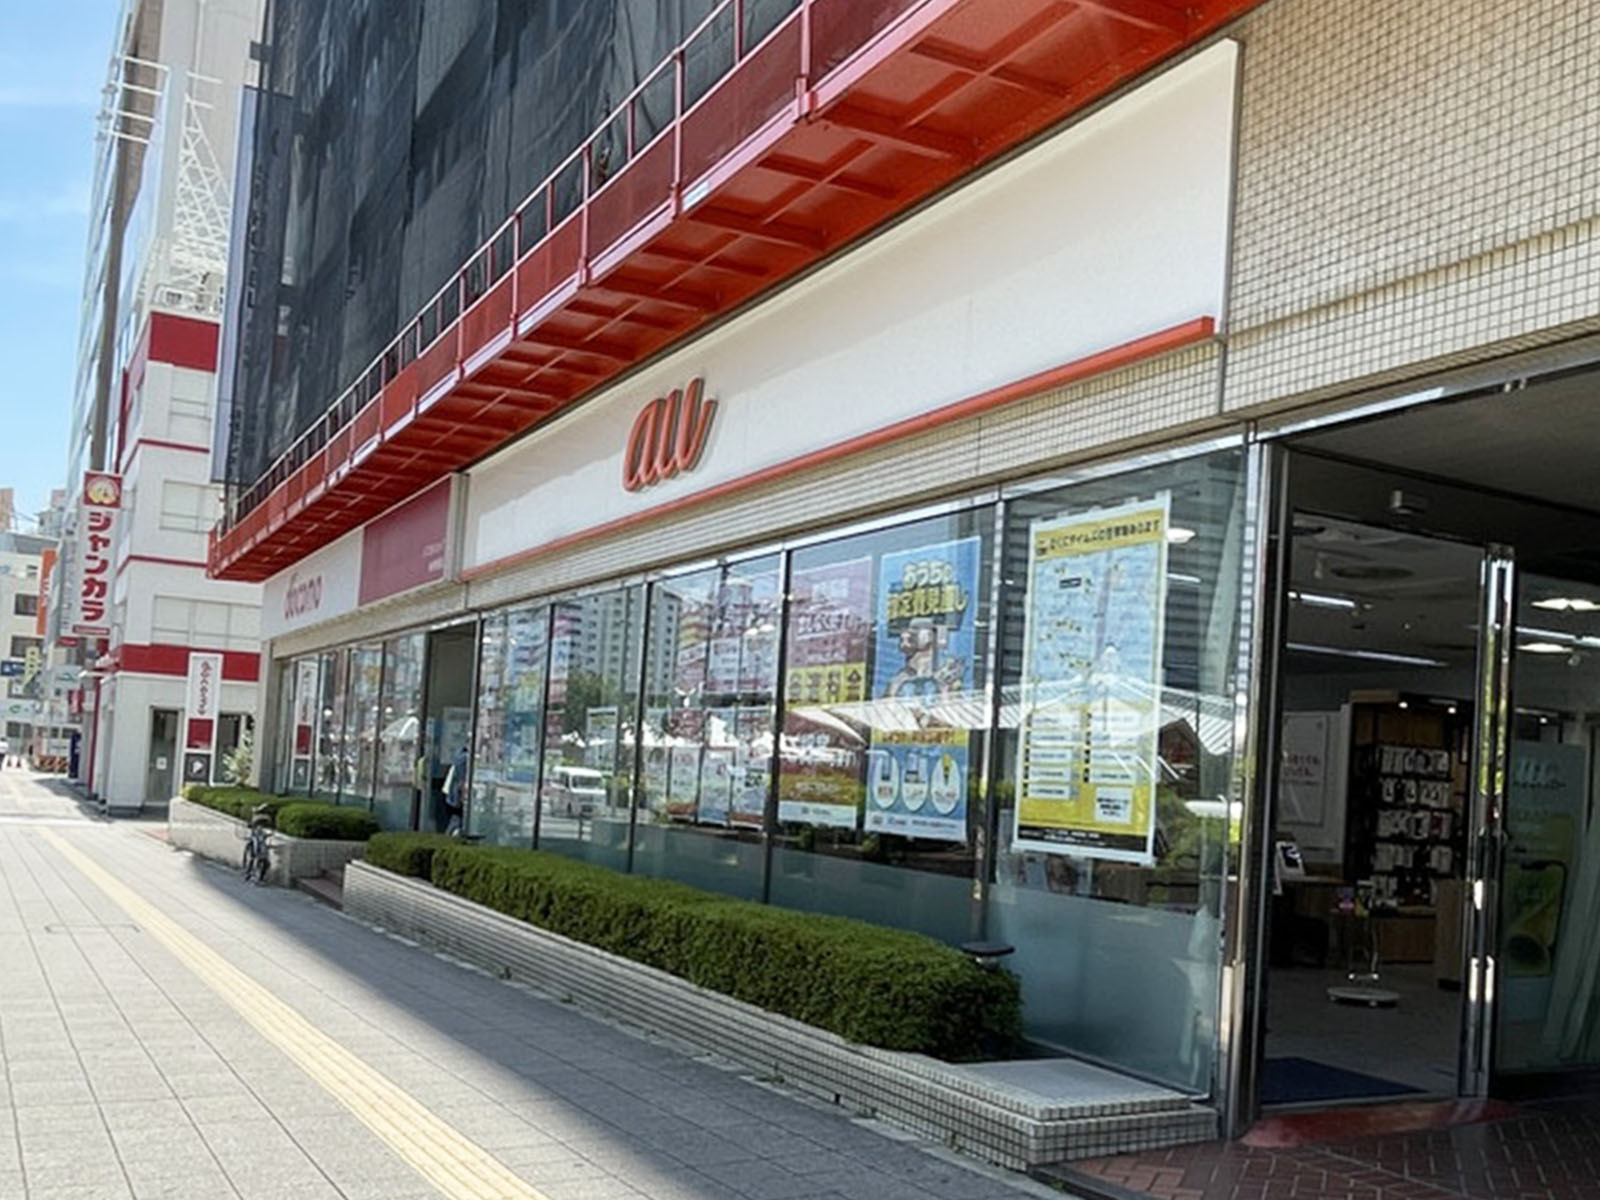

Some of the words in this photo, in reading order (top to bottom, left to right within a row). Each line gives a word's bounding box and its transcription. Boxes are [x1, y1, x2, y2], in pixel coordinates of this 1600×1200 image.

[623, 376, 718, 492] au
[81, 510, 113, 622] ジャンカラ
